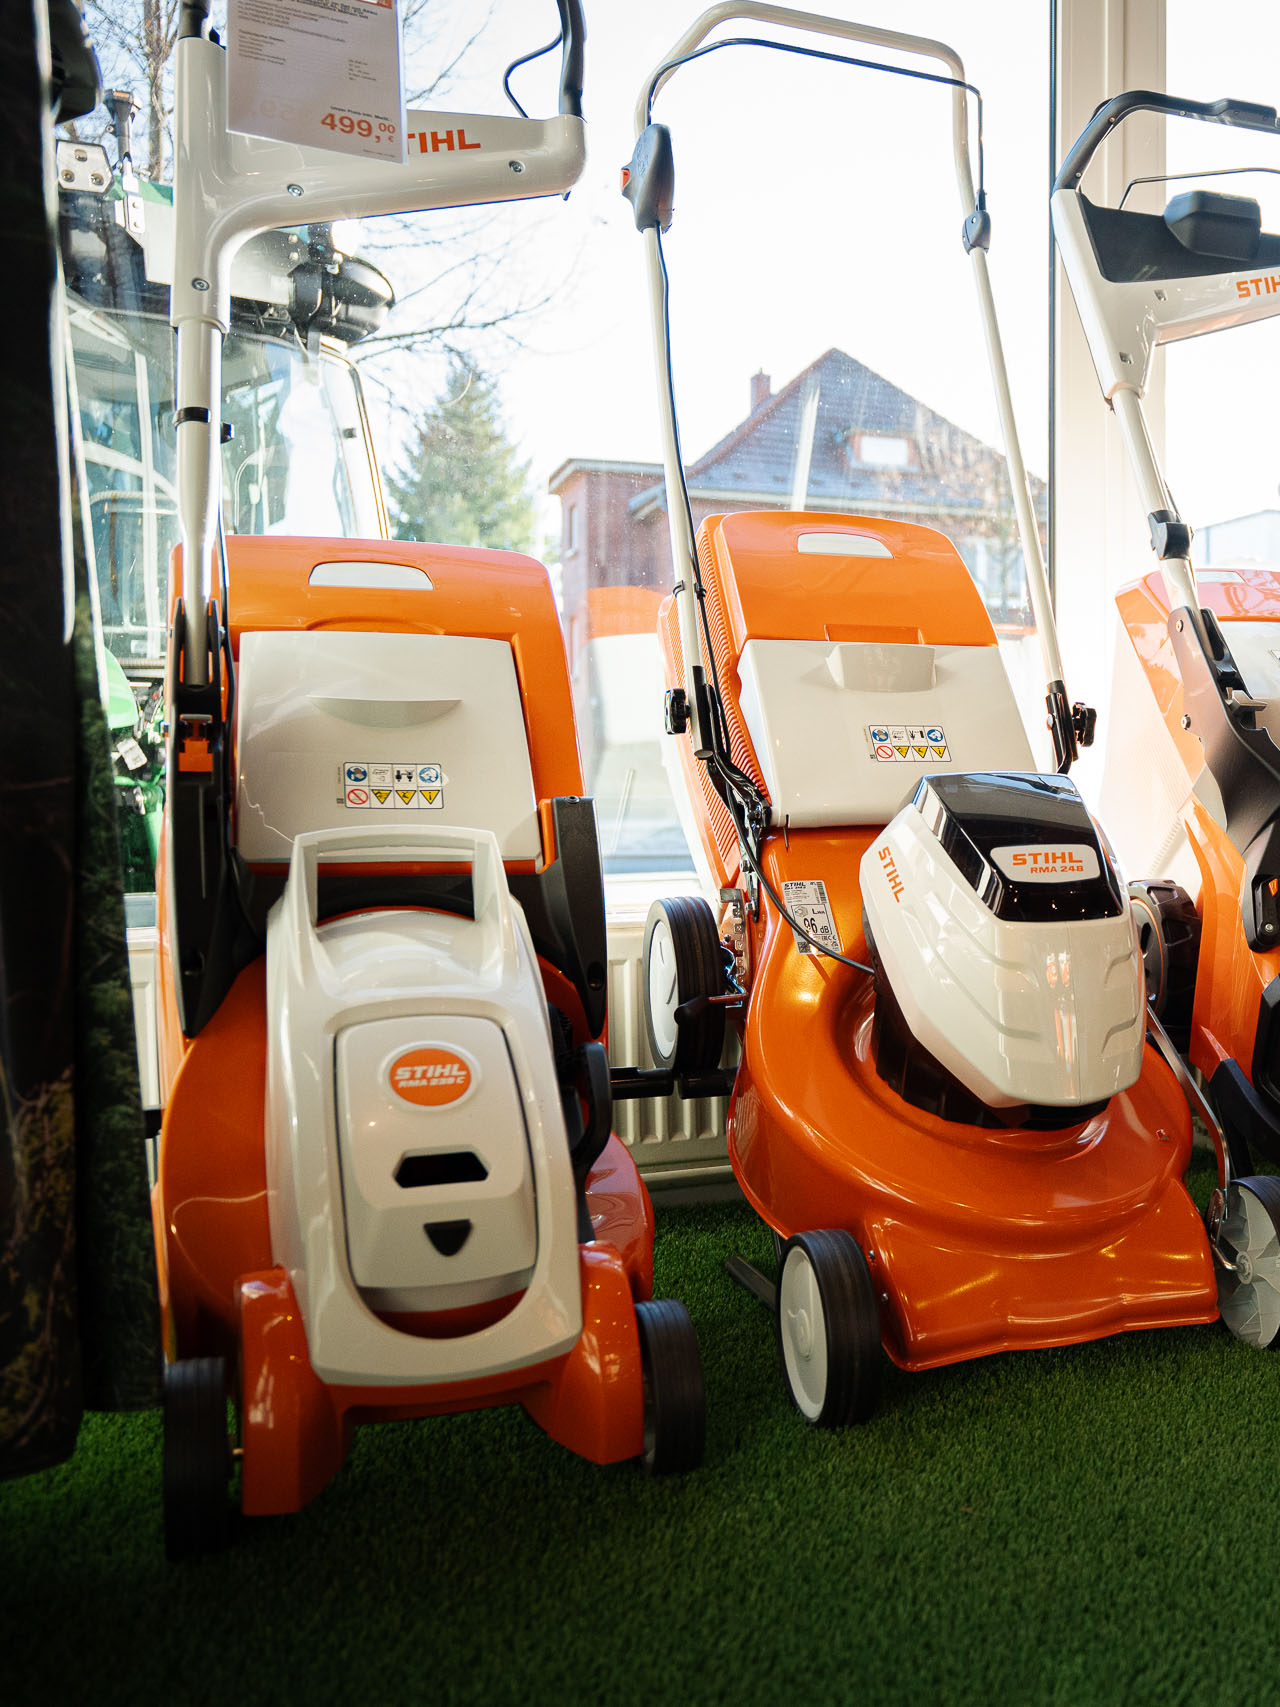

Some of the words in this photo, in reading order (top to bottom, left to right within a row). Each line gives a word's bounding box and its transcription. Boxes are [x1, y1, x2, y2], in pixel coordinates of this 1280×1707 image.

[1012, 851, 1083, 866] STIHL
[878, 846, 905, 903] STIHL
[1030, 866, 1058, 874] RMA
[1060, 865, 1084, 873] 248
[819, 925, 830, 934] dB
[394, 1063, 468, 1080] STIHL
